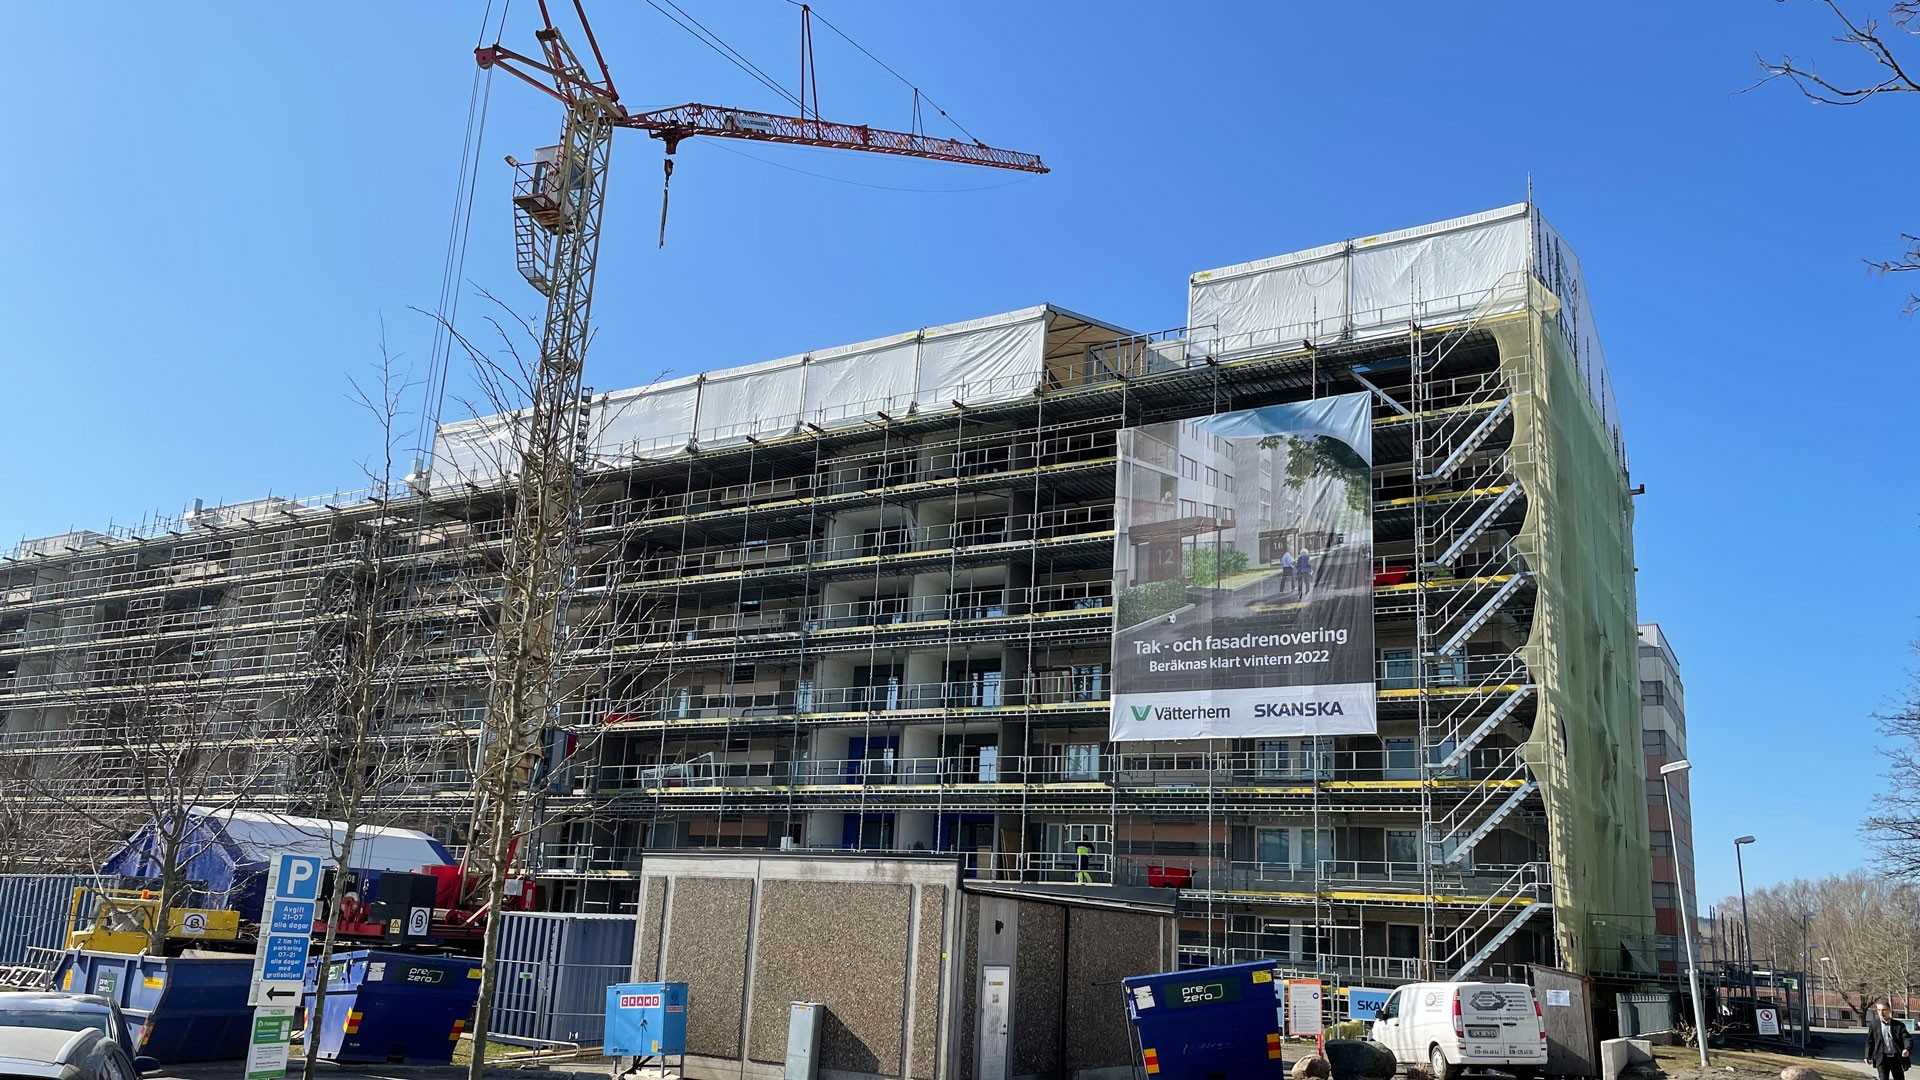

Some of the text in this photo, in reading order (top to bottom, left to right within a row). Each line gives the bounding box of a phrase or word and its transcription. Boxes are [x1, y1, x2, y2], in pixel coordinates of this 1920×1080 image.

[1157, 548, 1174, 566] 12
[1133, 639, 1161, 654] Tak
[1172, 636, 1202, 653] och
[1205, 627, 1348, 651] fasadrenovering
[1149, 650, 1330, 672] Beräknas klart vintern 2022
[1154, 704, 1231, 721] Vätterhem
[1253, 701, 1344, 718] SKANSKA
[286, 859, 314, 895] P
[283, 905, 305, 914] Avgift
[288, 922, 309, 930] dagar
[273, 945, 302, 953] parkering
[409, 967, 429, 976] pre
[407, 975, 433, 983] zero
[1181, 985, 1204, 996] pre
[1183, 993, 1213, 1003] zero
